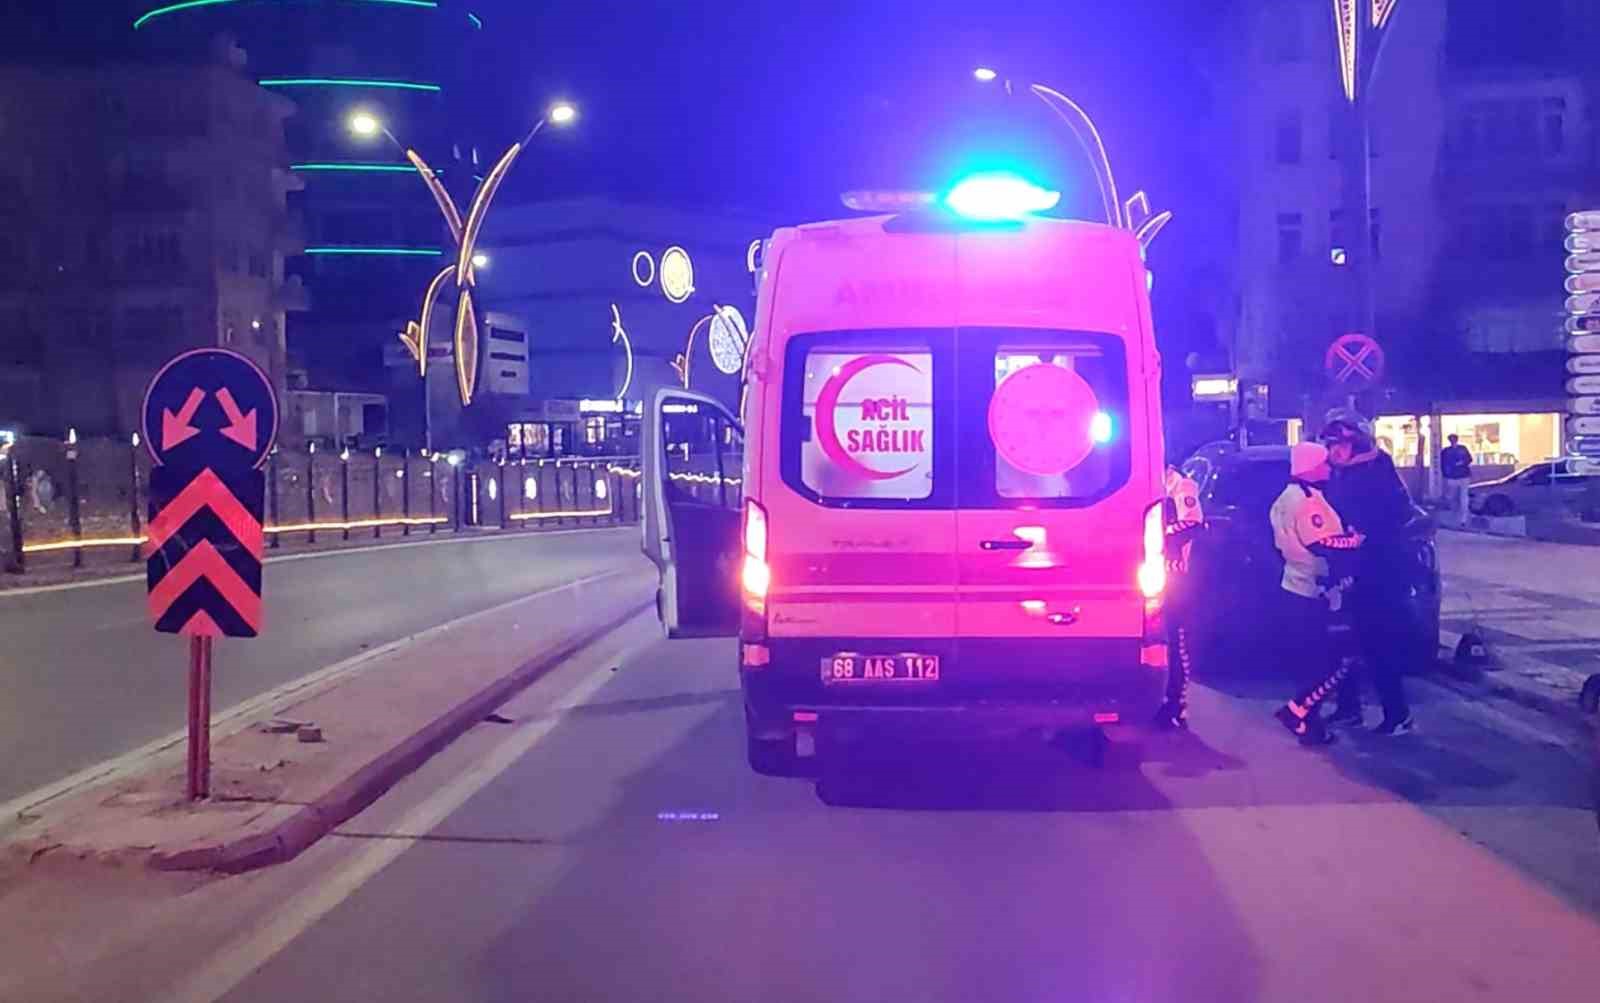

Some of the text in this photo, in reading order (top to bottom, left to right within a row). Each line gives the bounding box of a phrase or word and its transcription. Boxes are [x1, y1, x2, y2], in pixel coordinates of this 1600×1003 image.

[861, 394, 909, 421] ACİL
[847, 424, 925, 453] SAĞLIK
[833, 658, 854, 678] 68
[864, 658, 895, 678] AAS
[906, 658, 936, 678] 112
